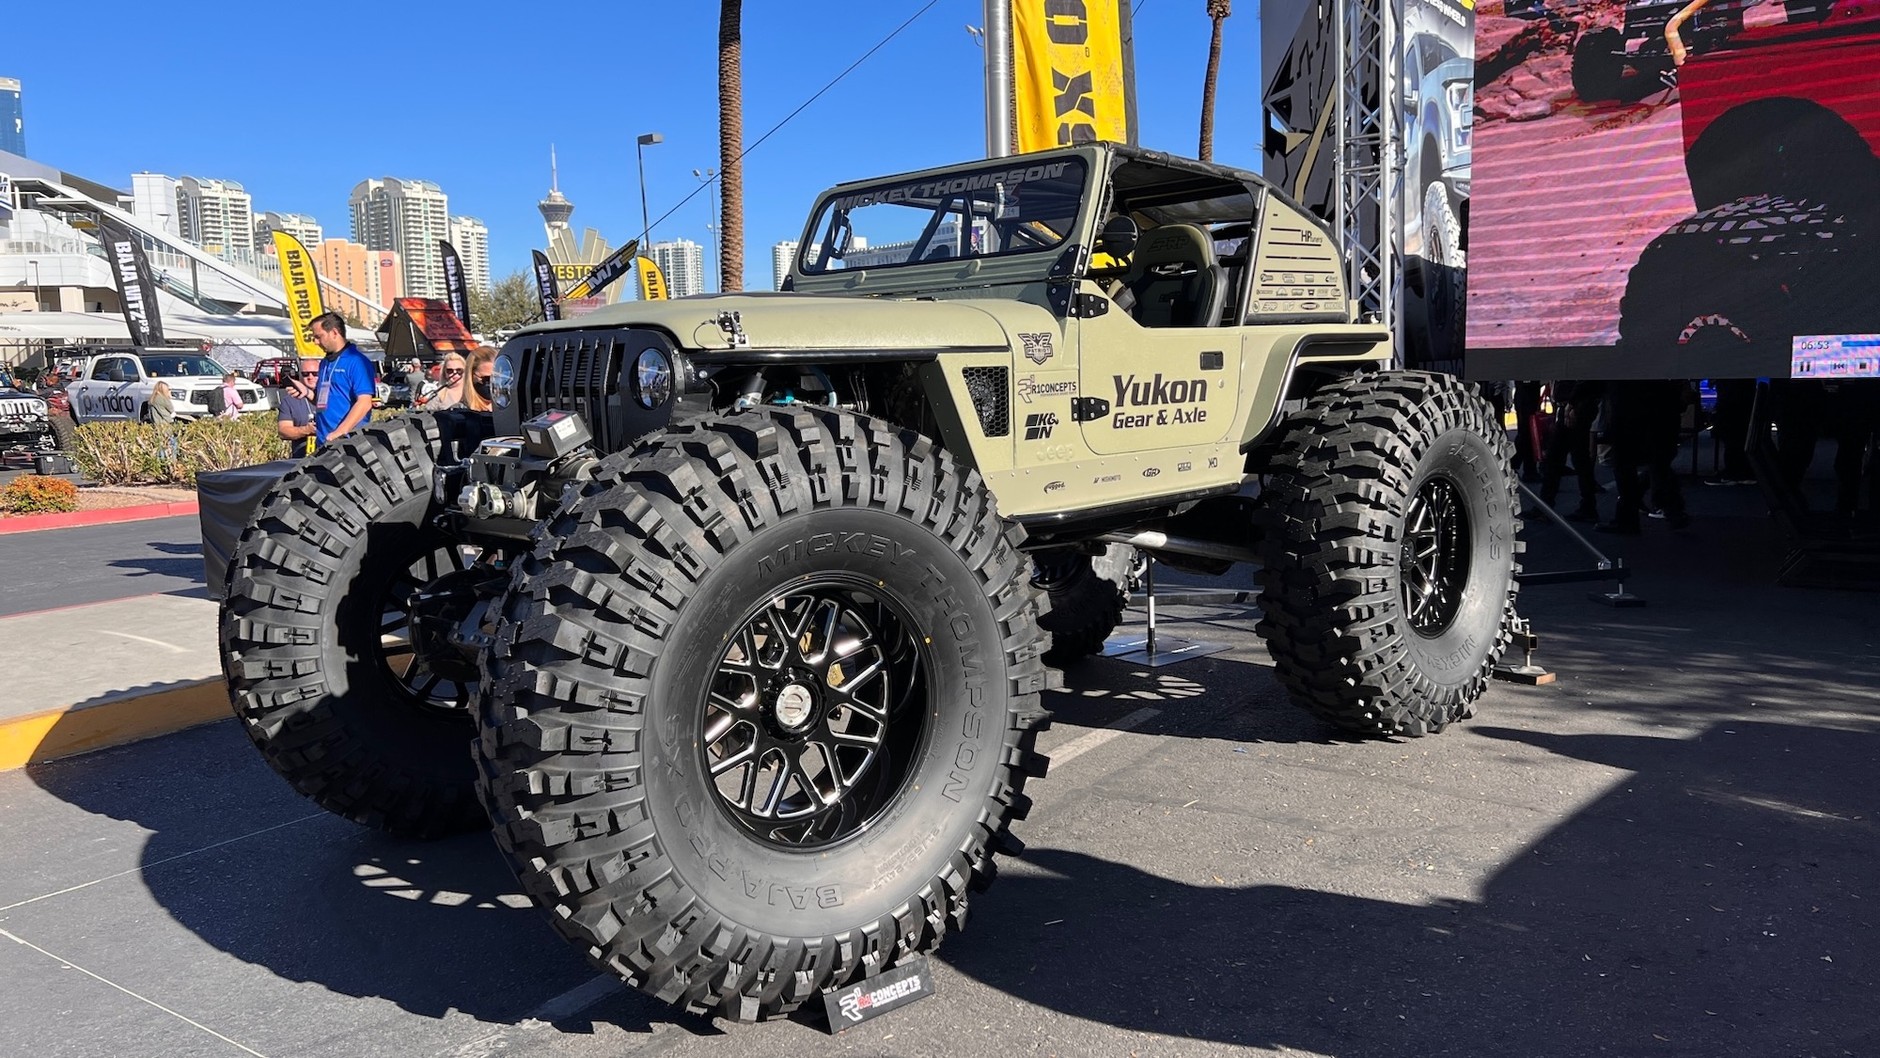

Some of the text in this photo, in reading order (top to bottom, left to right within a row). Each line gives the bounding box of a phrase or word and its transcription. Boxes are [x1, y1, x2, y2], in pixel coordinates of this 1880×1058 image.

[834, 163, 1066, 212] MICKEY THOMPSON
[114, 241, 139, 283] BAJA
[286, 249, 306, 287] BAJA
[123, 284, 147, 321] MTZ
[446, 255, 464, 322] BAJA BOS
[646, 270, 659, 300] BAJA
[294, 289, 313, 320] PRO
[1801, 340, 1830, 350] 06:53
[1031, 381, 1078, 395] R1CONCEPTS
[1112, 373, 1208, 407] Yukon
[1112, 407, 1207, 429] Gear & Axle
[756, 531, 985, 803] MICKEY THOMPSON
[740, 868, 845, 910] BAJA
